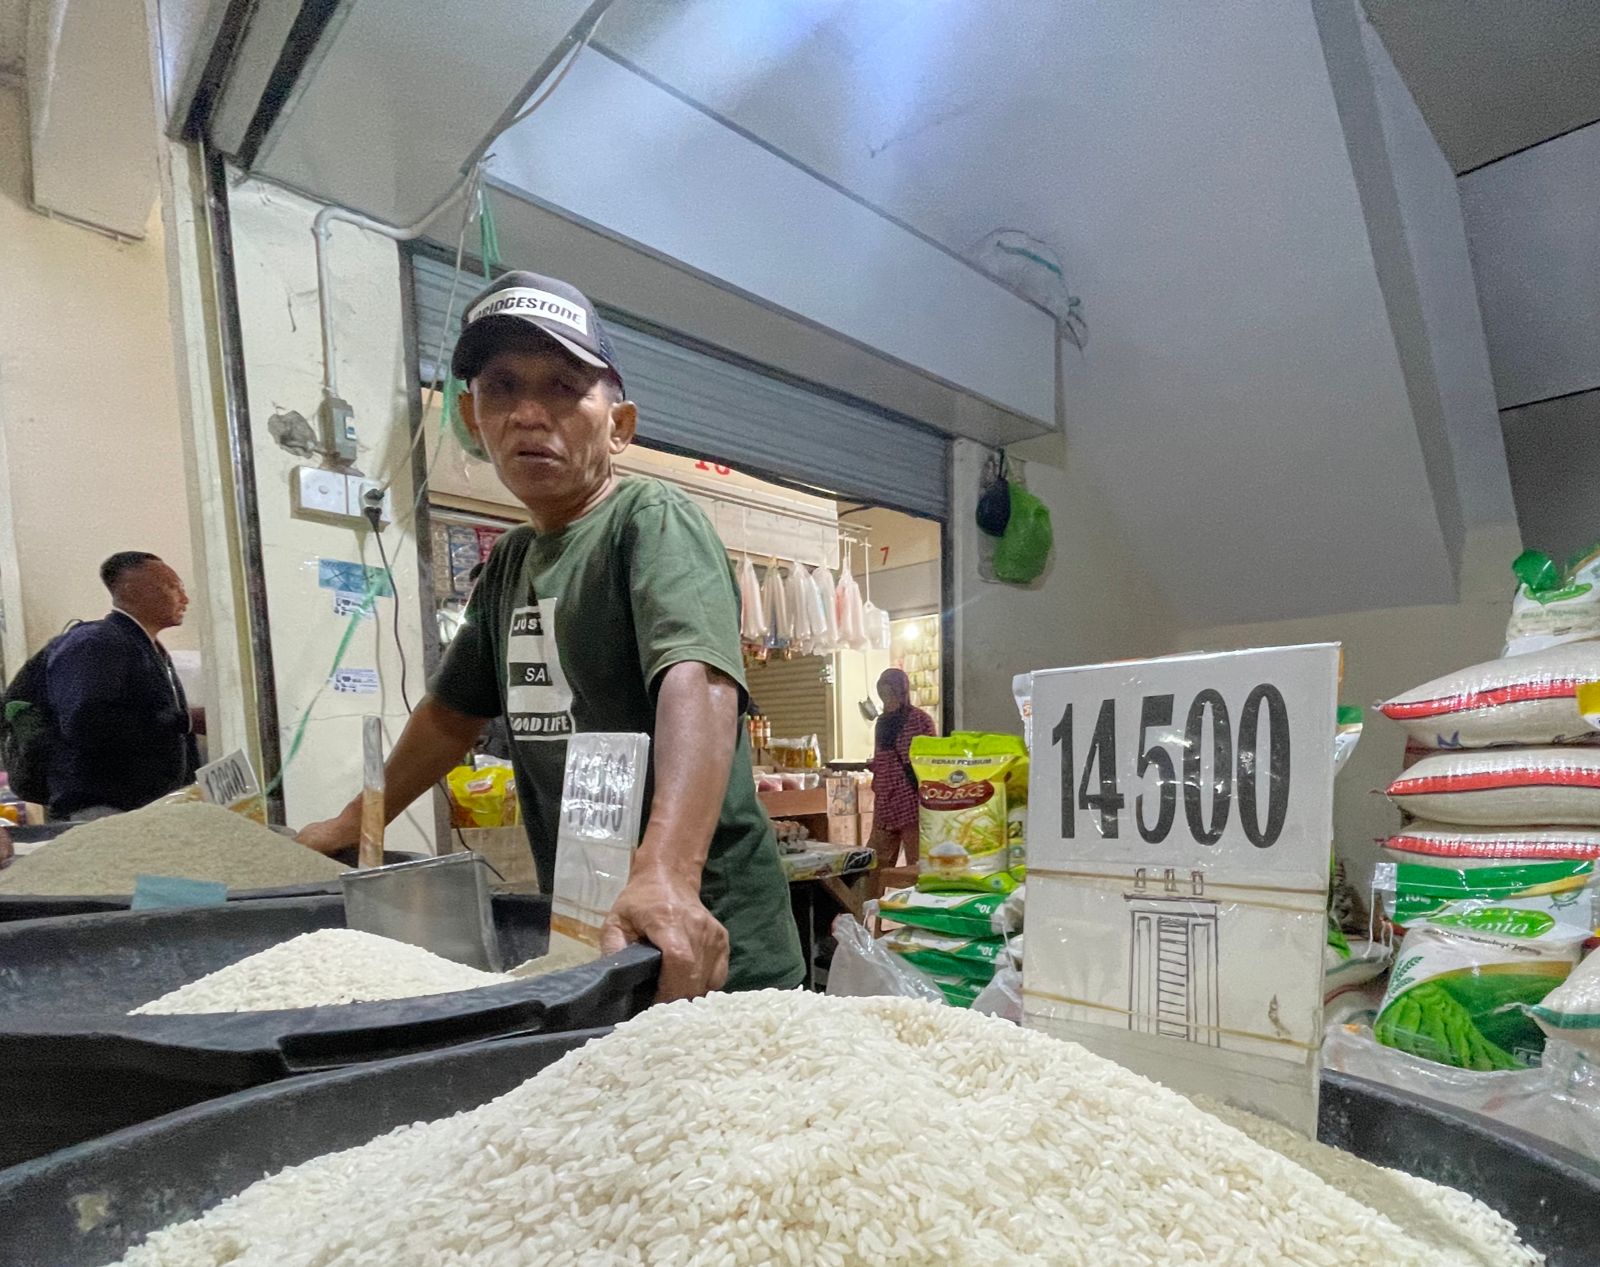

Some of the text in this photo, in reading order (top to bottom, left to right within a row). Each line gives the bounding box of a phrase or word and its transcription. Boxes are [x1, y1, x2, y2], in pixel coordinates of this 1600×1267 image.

[880, 546, 889, 566] 7
[513, 618, 541, 631] JUS
[543, 715, 570, 732] LIFE
[1051, 683, 1290, 848] 14500
[953, 784, 985, 799] RICE
